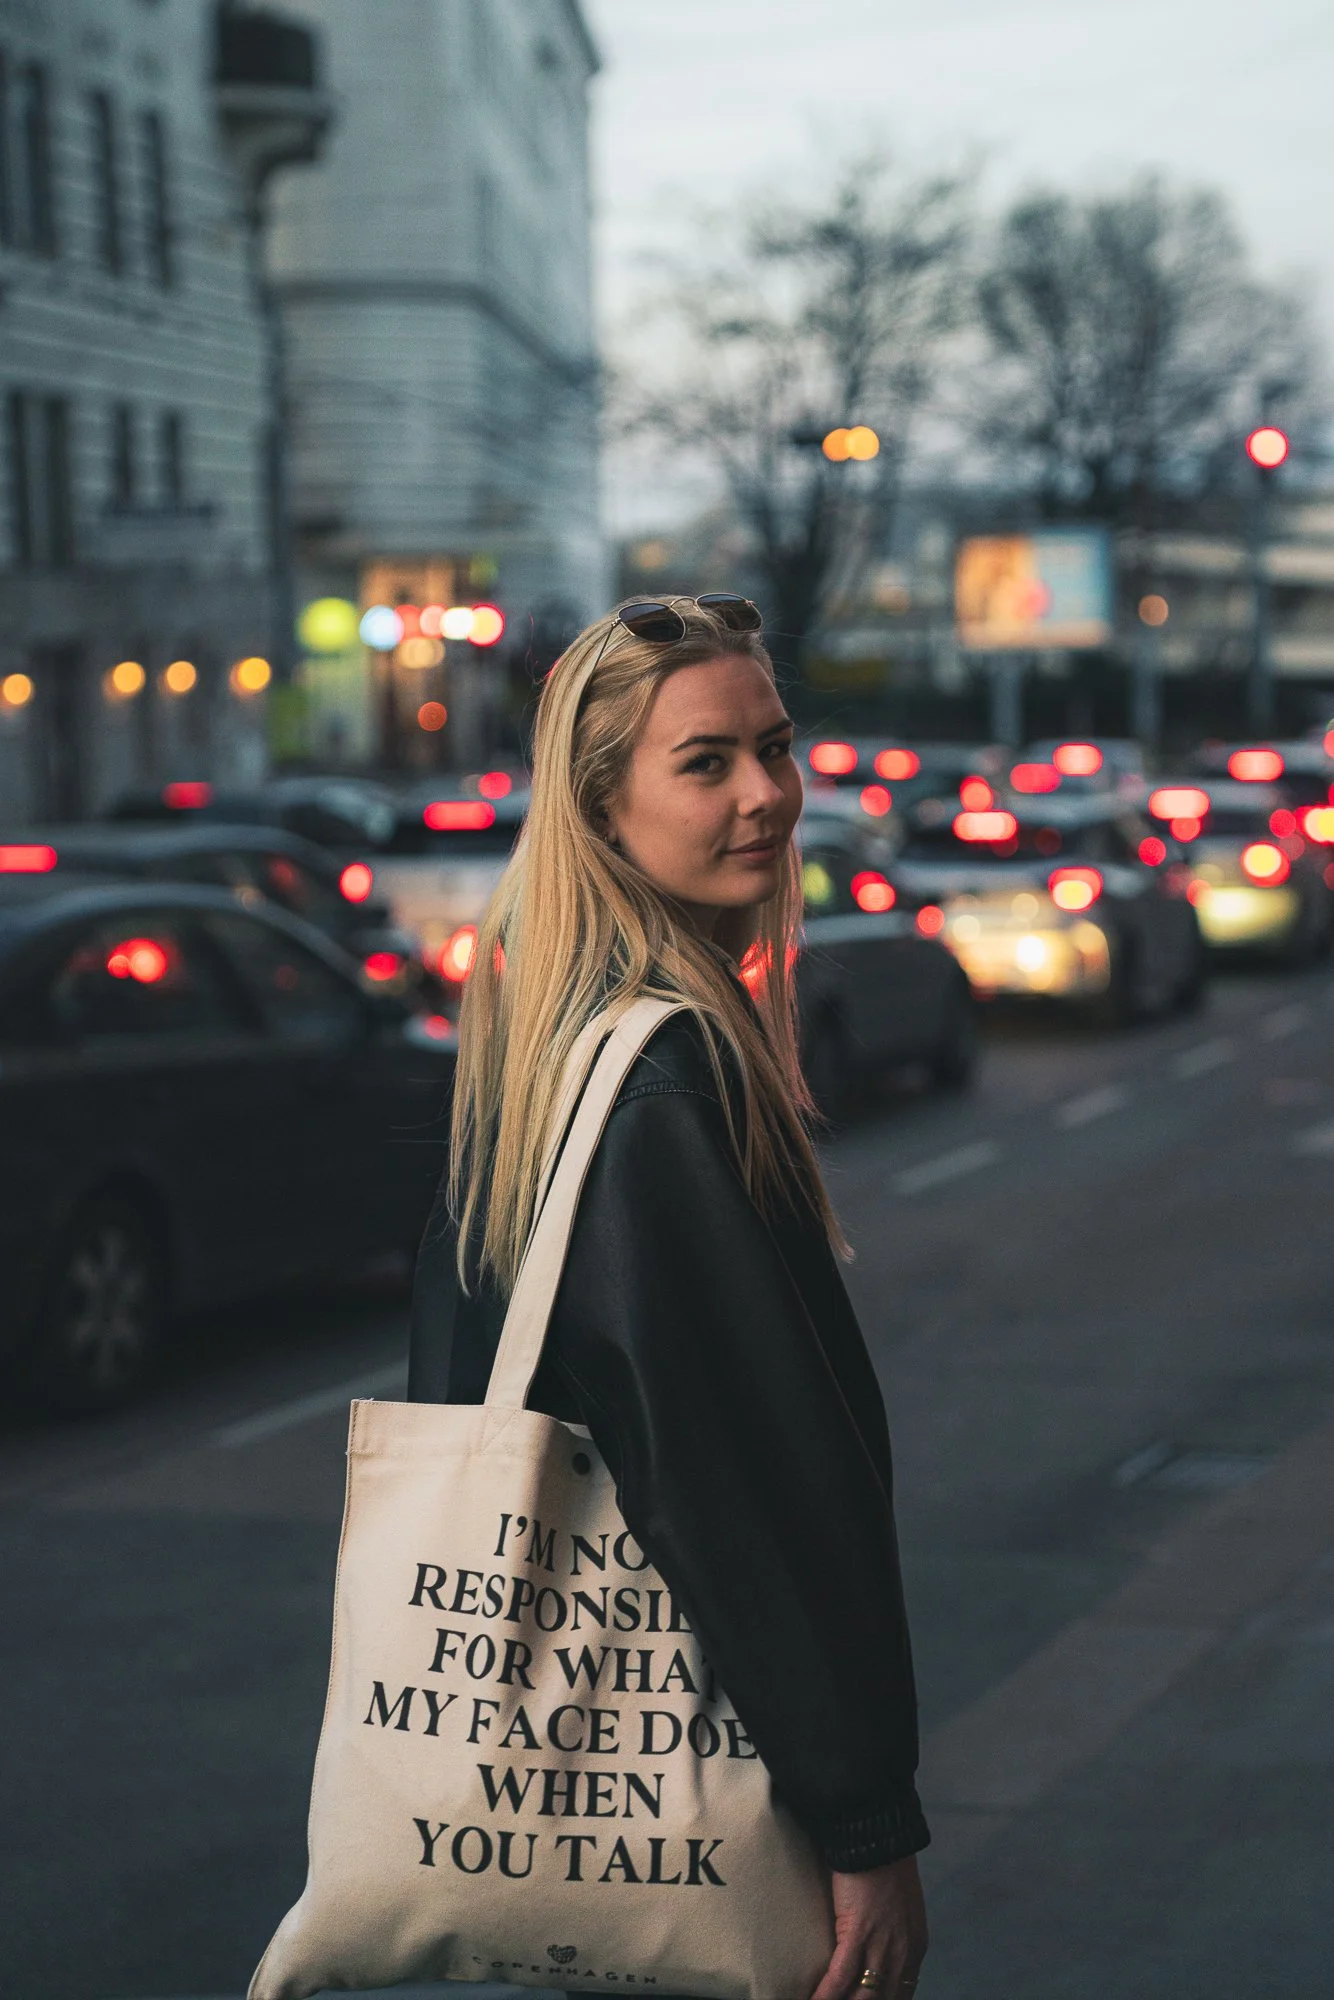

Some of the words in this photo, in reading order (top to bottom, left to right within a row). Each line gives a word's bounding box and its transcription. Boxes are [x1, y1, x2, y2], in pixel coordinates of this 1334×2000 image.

[428, 1628, 536, 1690] FOR
[363, 1681, 458, 1736] MY
[466, 1698, 620, 1755] FACE
[638, 1711, 757, 1759] DOE
[477, 1764, 665, 1818] WHEN
[412, 1817, 538, 1878] YOU
[554, 1835, 727, 1886] TALK
